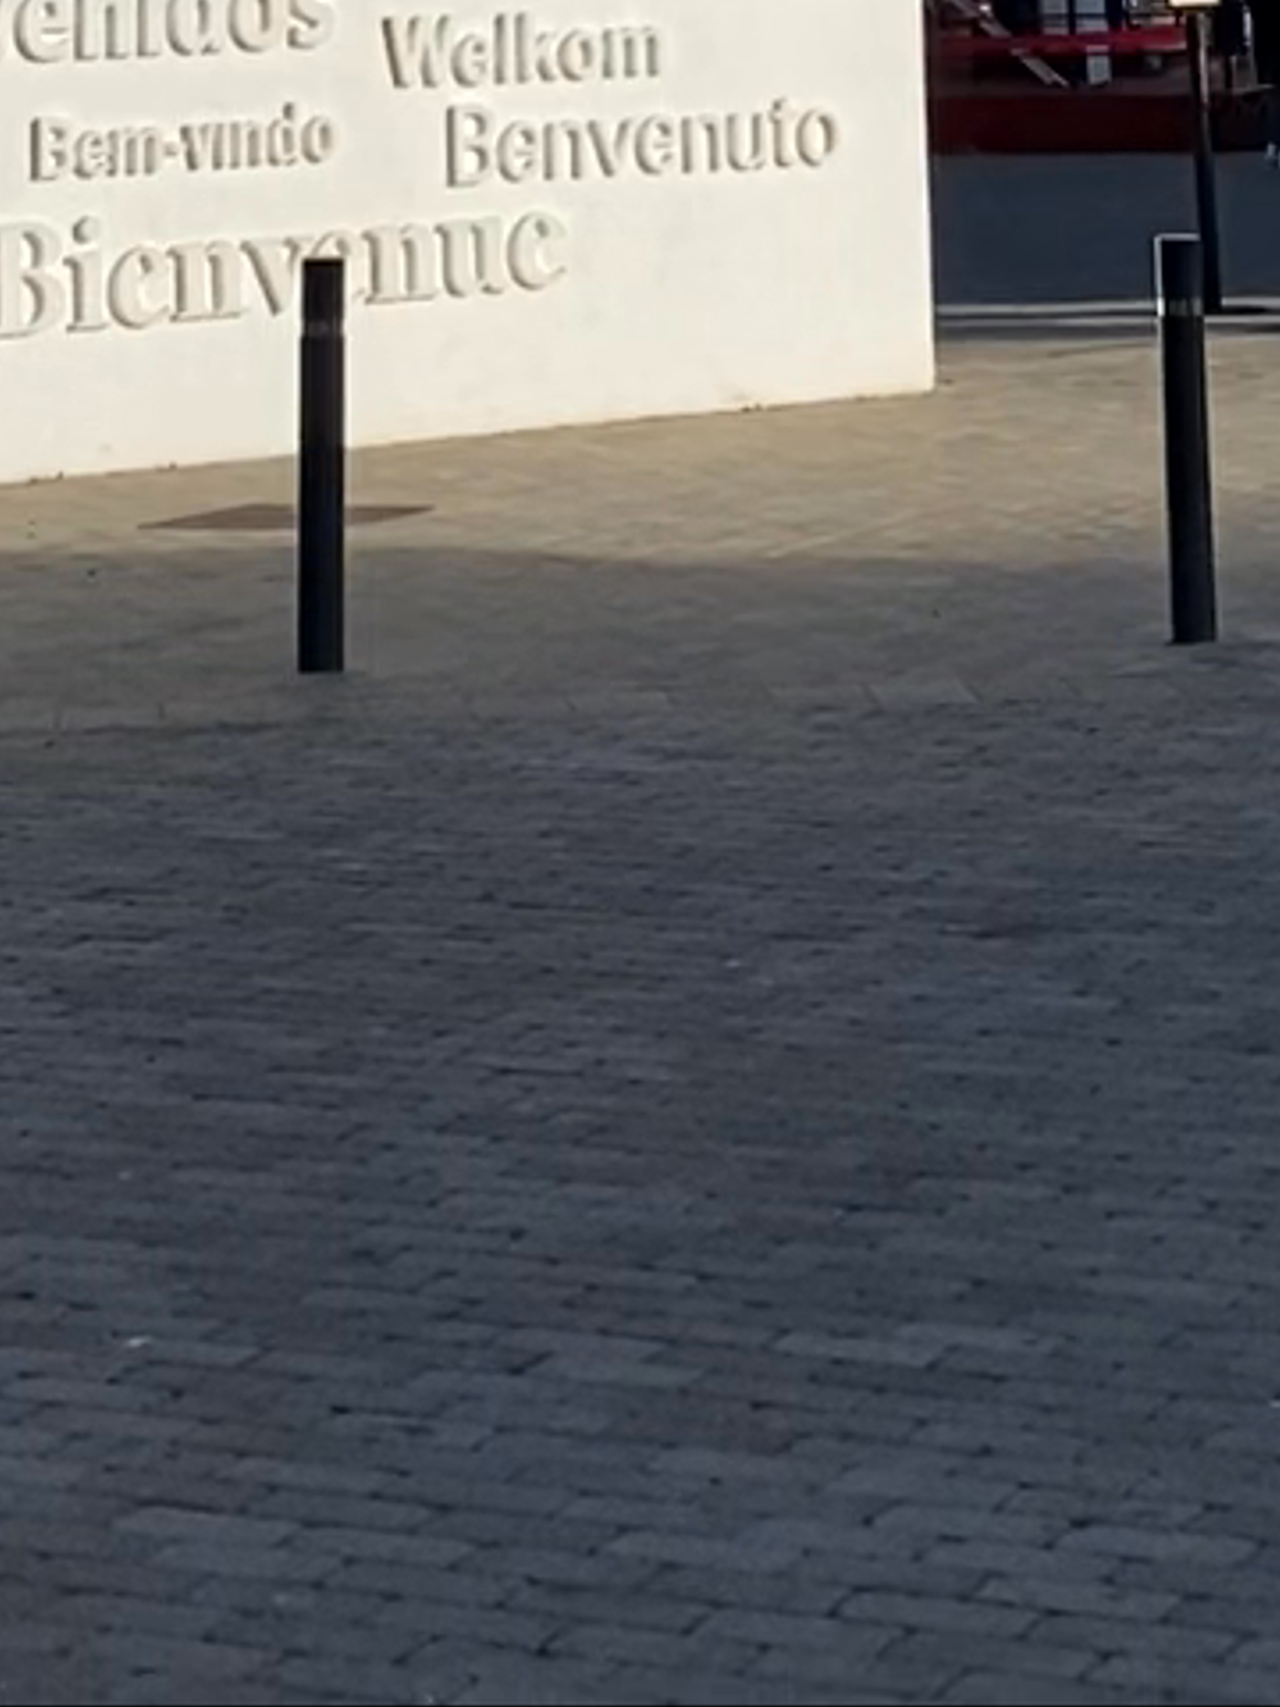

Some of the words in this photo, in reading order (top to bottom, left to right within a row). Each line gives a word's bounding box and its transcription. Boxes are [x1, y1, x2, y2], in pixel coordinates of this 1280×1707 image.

[380, 12, 662, 90] Welkom
[29, 101, 334, 182] Bem-vindo
[444, 98, 839, 189] Benvenuto
